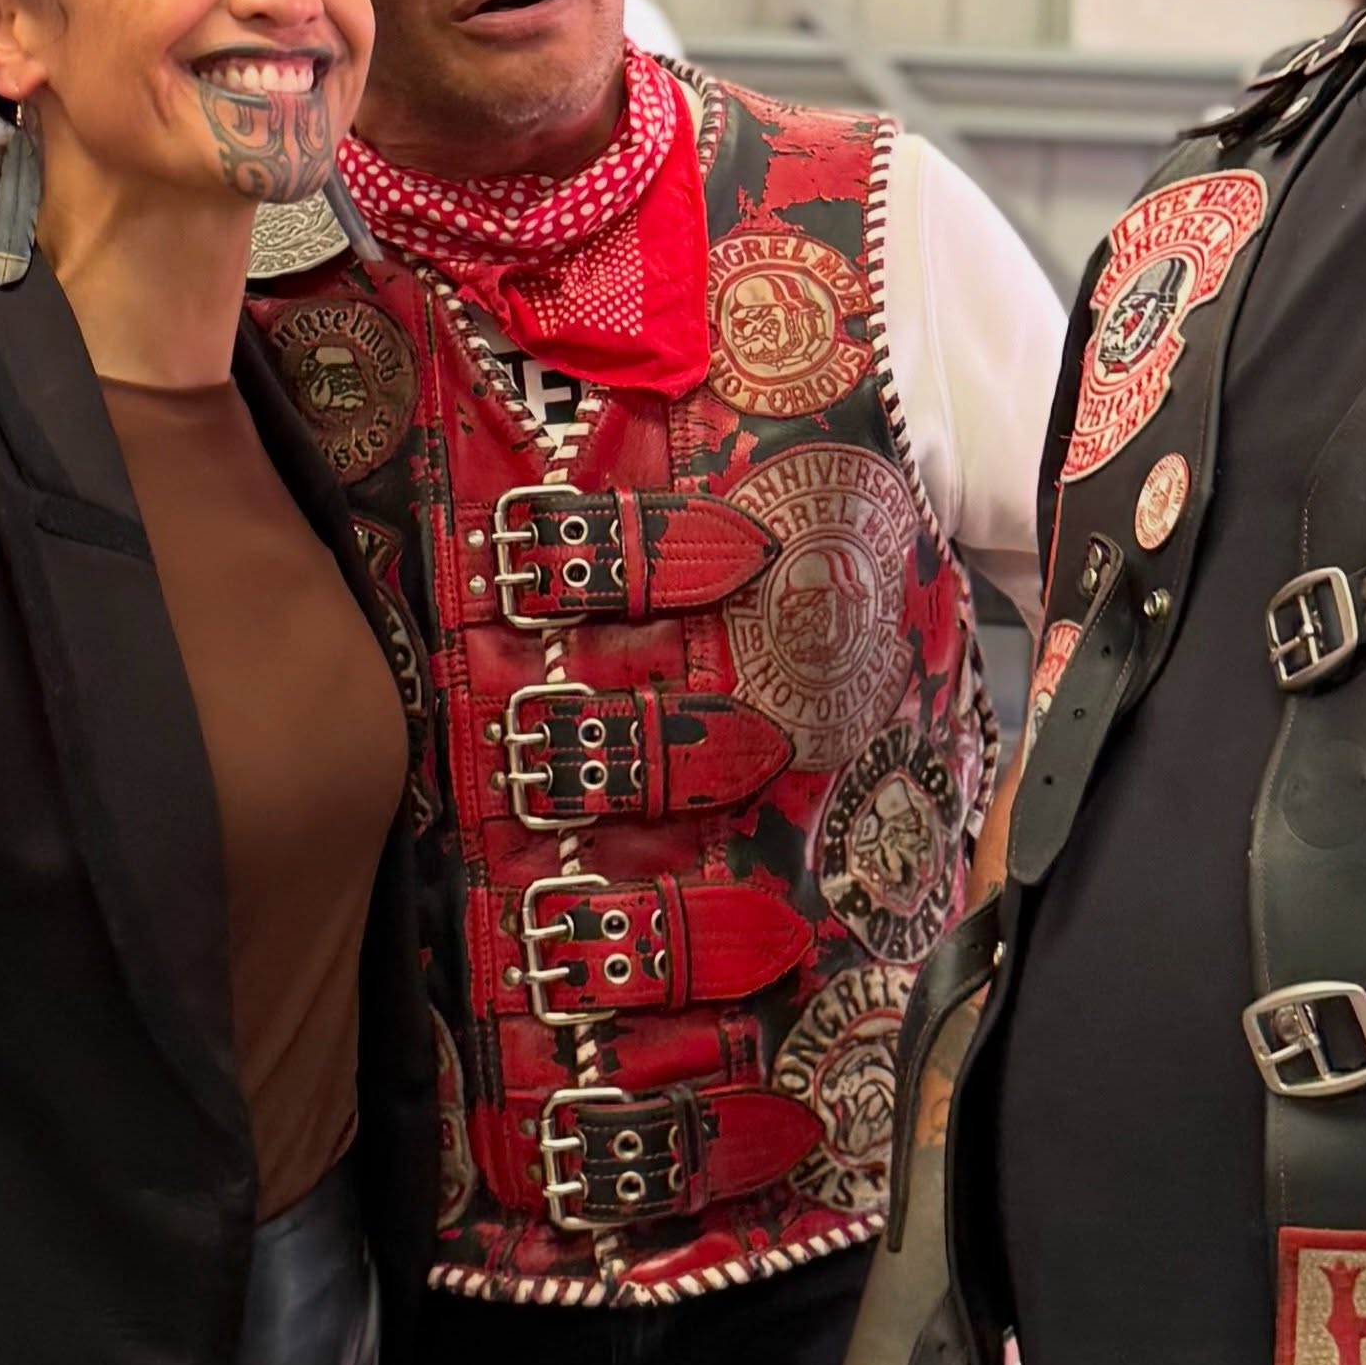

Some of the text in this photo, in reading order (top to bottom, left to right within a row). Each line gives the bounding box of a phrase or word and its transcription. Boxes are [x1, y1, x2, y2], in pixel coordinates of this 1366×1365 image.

[1118, 187, 1193, 241] LIFE
[708, 237, 866, 319] NGREL MOB
[709, 347, 864, 411] NOTORIOUS
[737, 455, 918, 540] ANNIVERSARY
[731, 497, 898, 611] MGREL MOB
[753, 629, 893, 721] NOTORIOUS
[779, 966, 899, 1094] ONGREL
